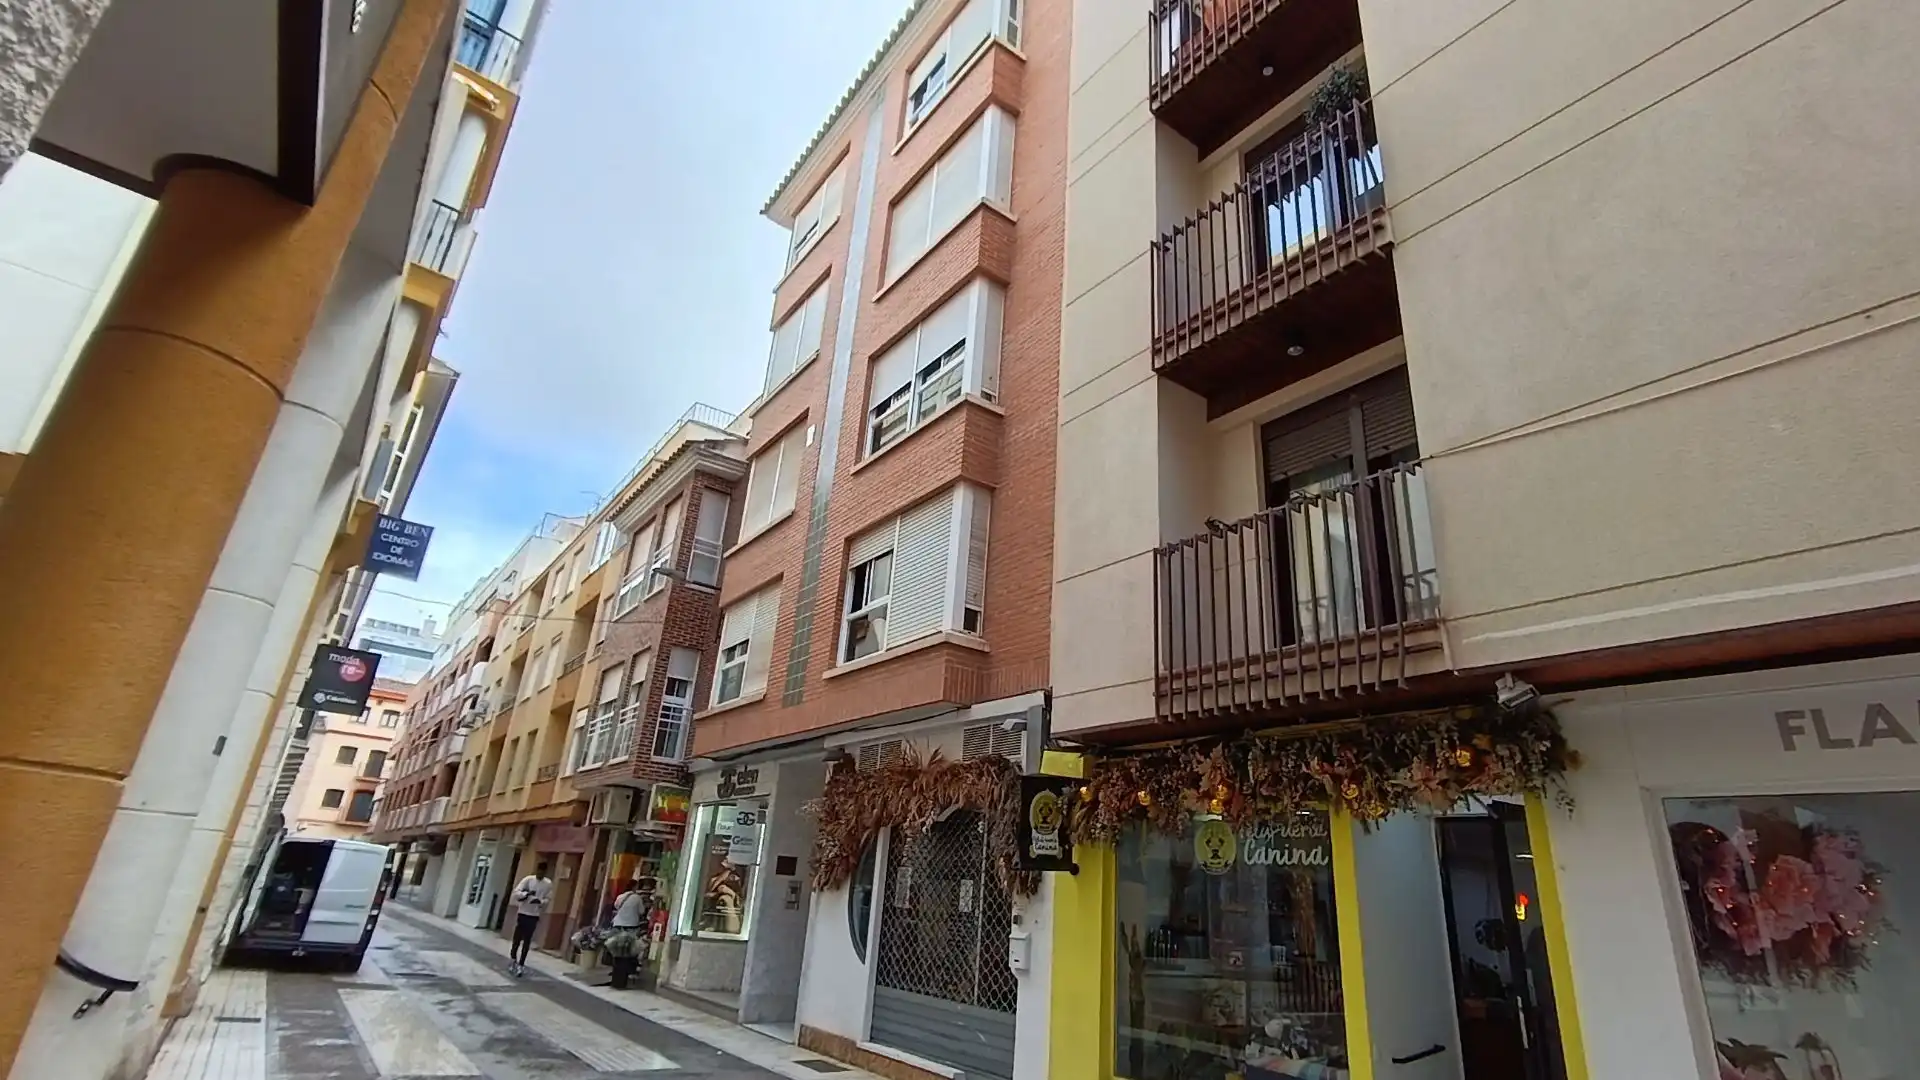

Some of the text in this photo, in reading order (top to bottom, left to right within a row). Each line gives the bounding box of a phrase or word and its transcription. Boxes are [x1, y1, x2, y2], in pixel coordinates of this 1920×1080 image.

[379, 518, 431, 538] BIG BEN
[380, 533, 420, 548] CENTRO
[390, 545, 404, 555] DE
[371, 551, 414, 568] IDIOMAS
[328, 653, 361, 666] moda
[1775, 700, 1920, 752] FLA
[1244, 837, 1330, 866] Canina
